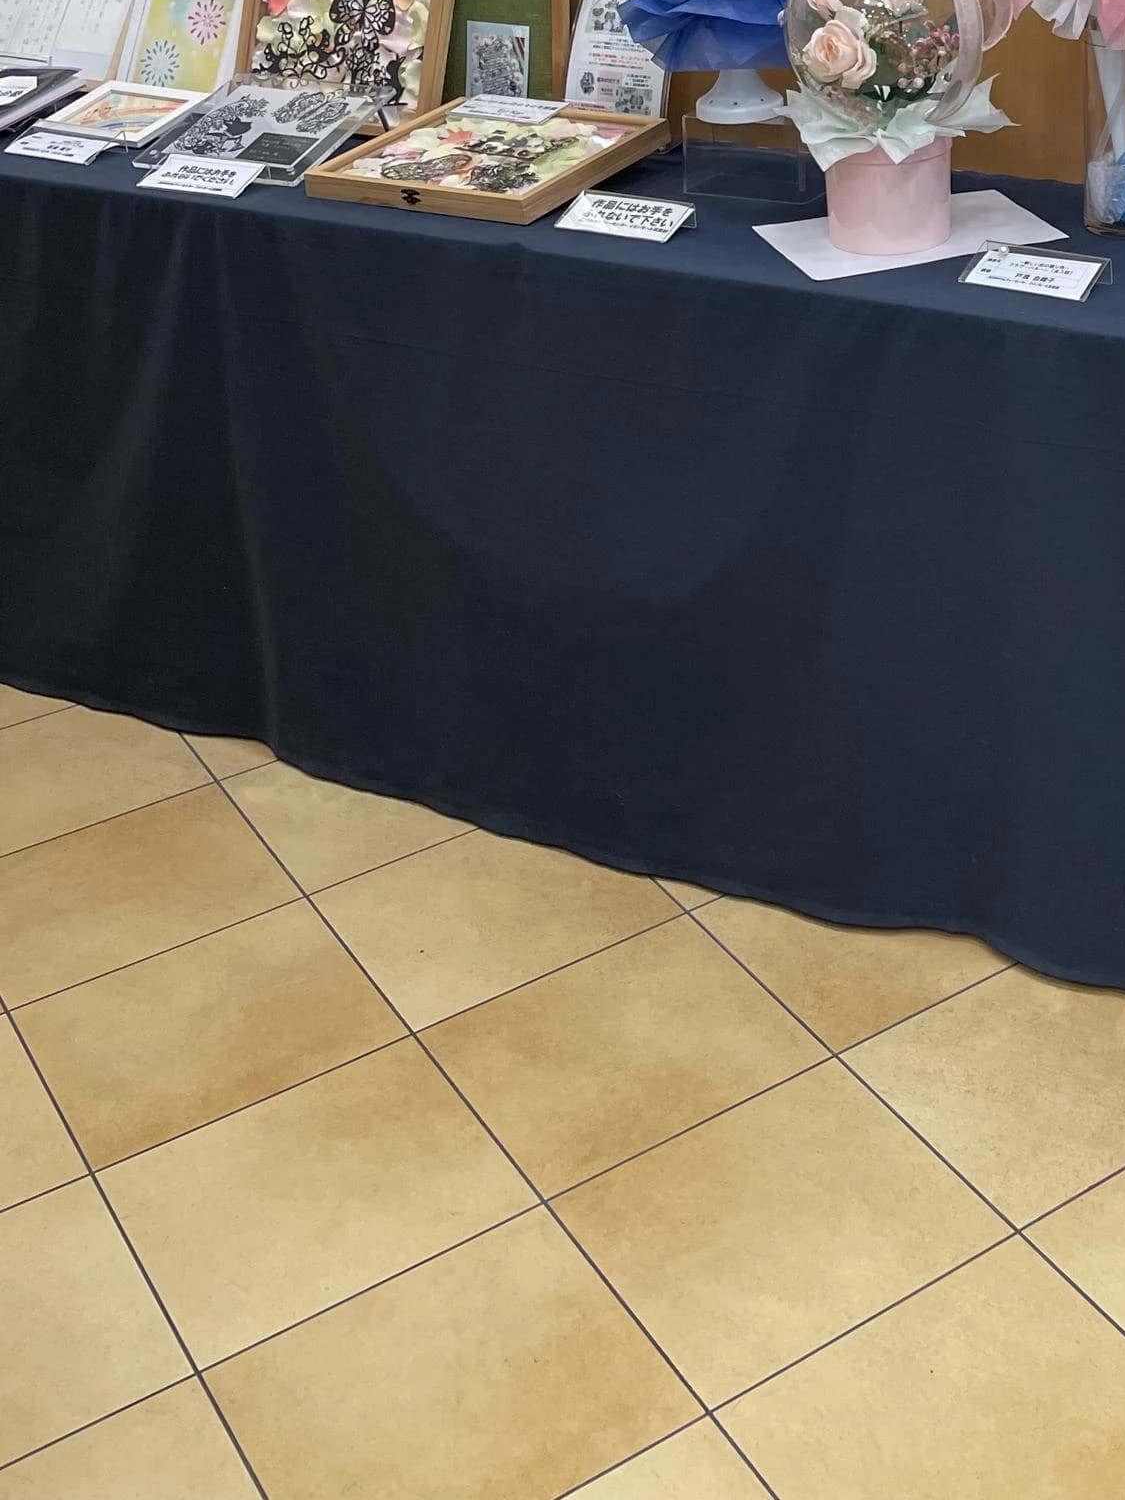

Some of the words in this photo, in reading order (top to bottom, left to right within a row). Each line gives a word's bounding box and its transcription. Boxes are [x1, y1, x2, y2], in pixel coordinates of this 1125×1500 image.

[592, 199, 674, 217] 作品にはお手を
